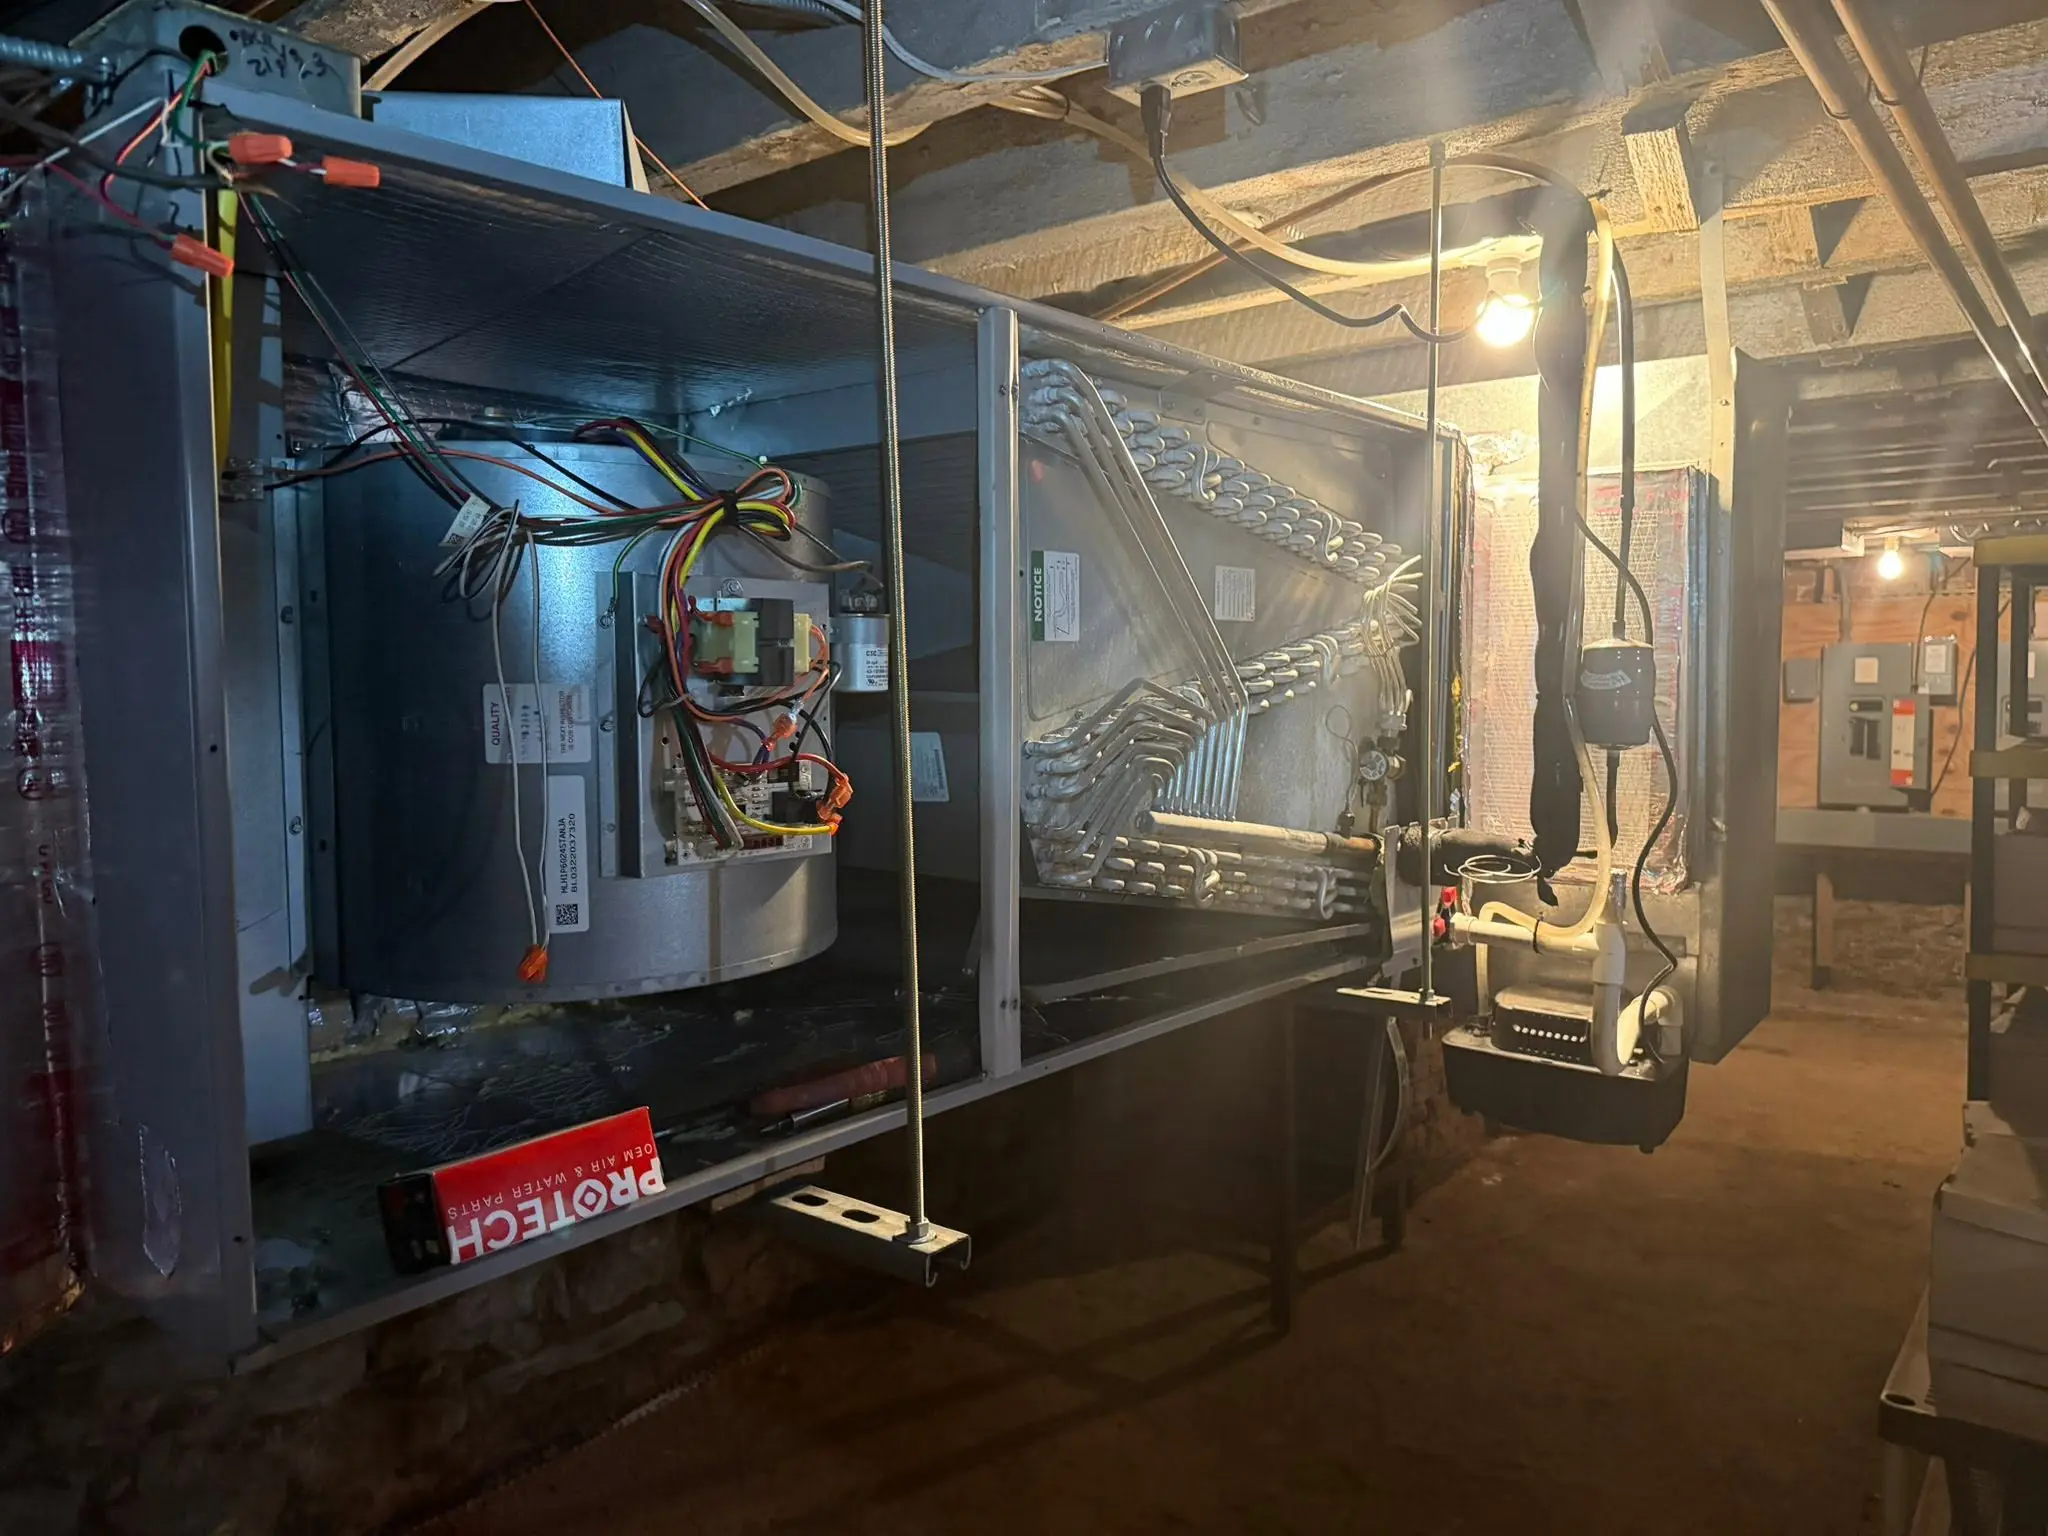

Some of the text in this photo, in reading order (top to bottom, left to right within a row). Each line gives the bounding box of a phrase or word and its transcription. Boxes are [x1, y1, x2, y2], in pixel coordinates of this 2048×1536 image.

[1033, 567, 1043, 622] NOTICE
[490, 701, 501, 746] QUALITY
[447, 1157, 667, 1265] PROTECH
[448, 1142, 653, 1220] OEM AIR & WATER PARTS
